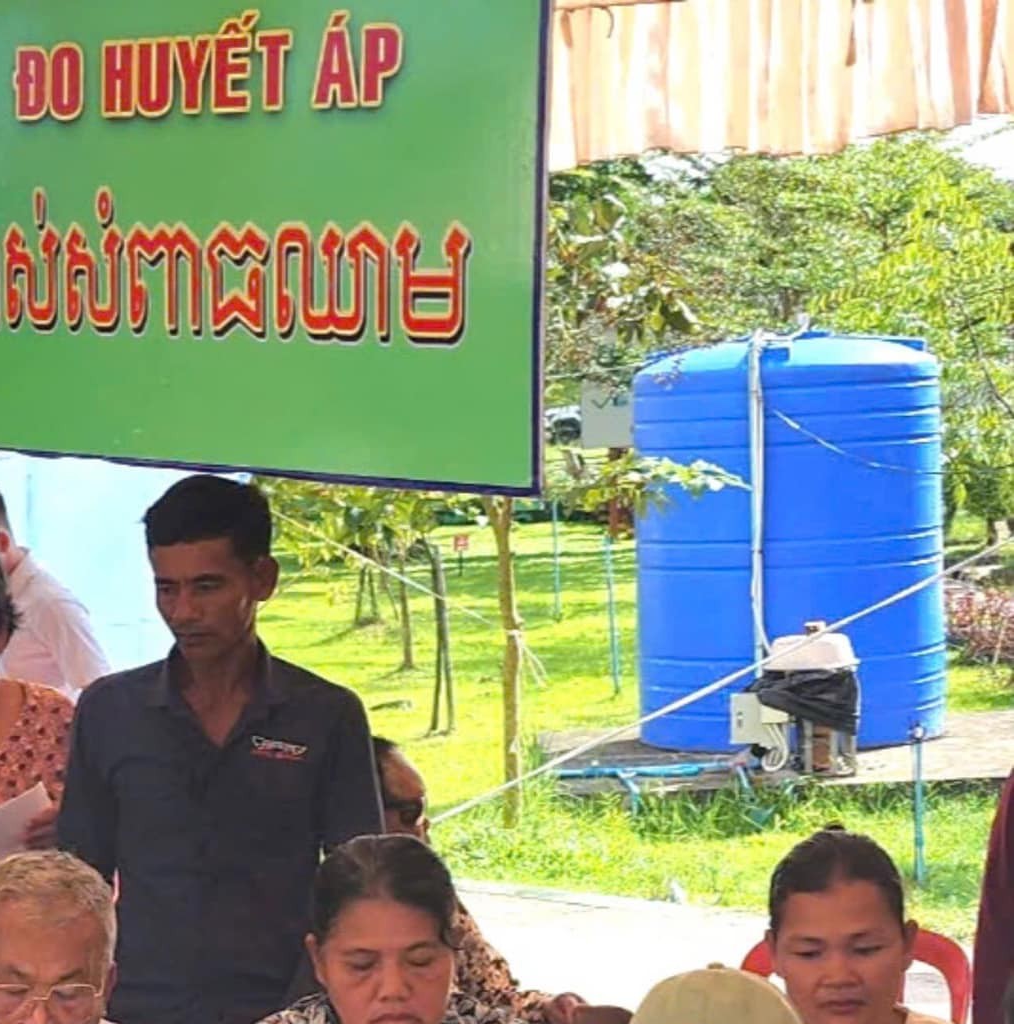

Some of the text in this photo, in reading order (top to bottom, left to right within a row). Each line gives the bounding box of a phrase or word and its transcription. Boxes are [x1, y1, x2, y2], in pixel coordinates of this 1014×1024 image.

[13, 10, 403, 121] ĐO HUYẾT ÁP
